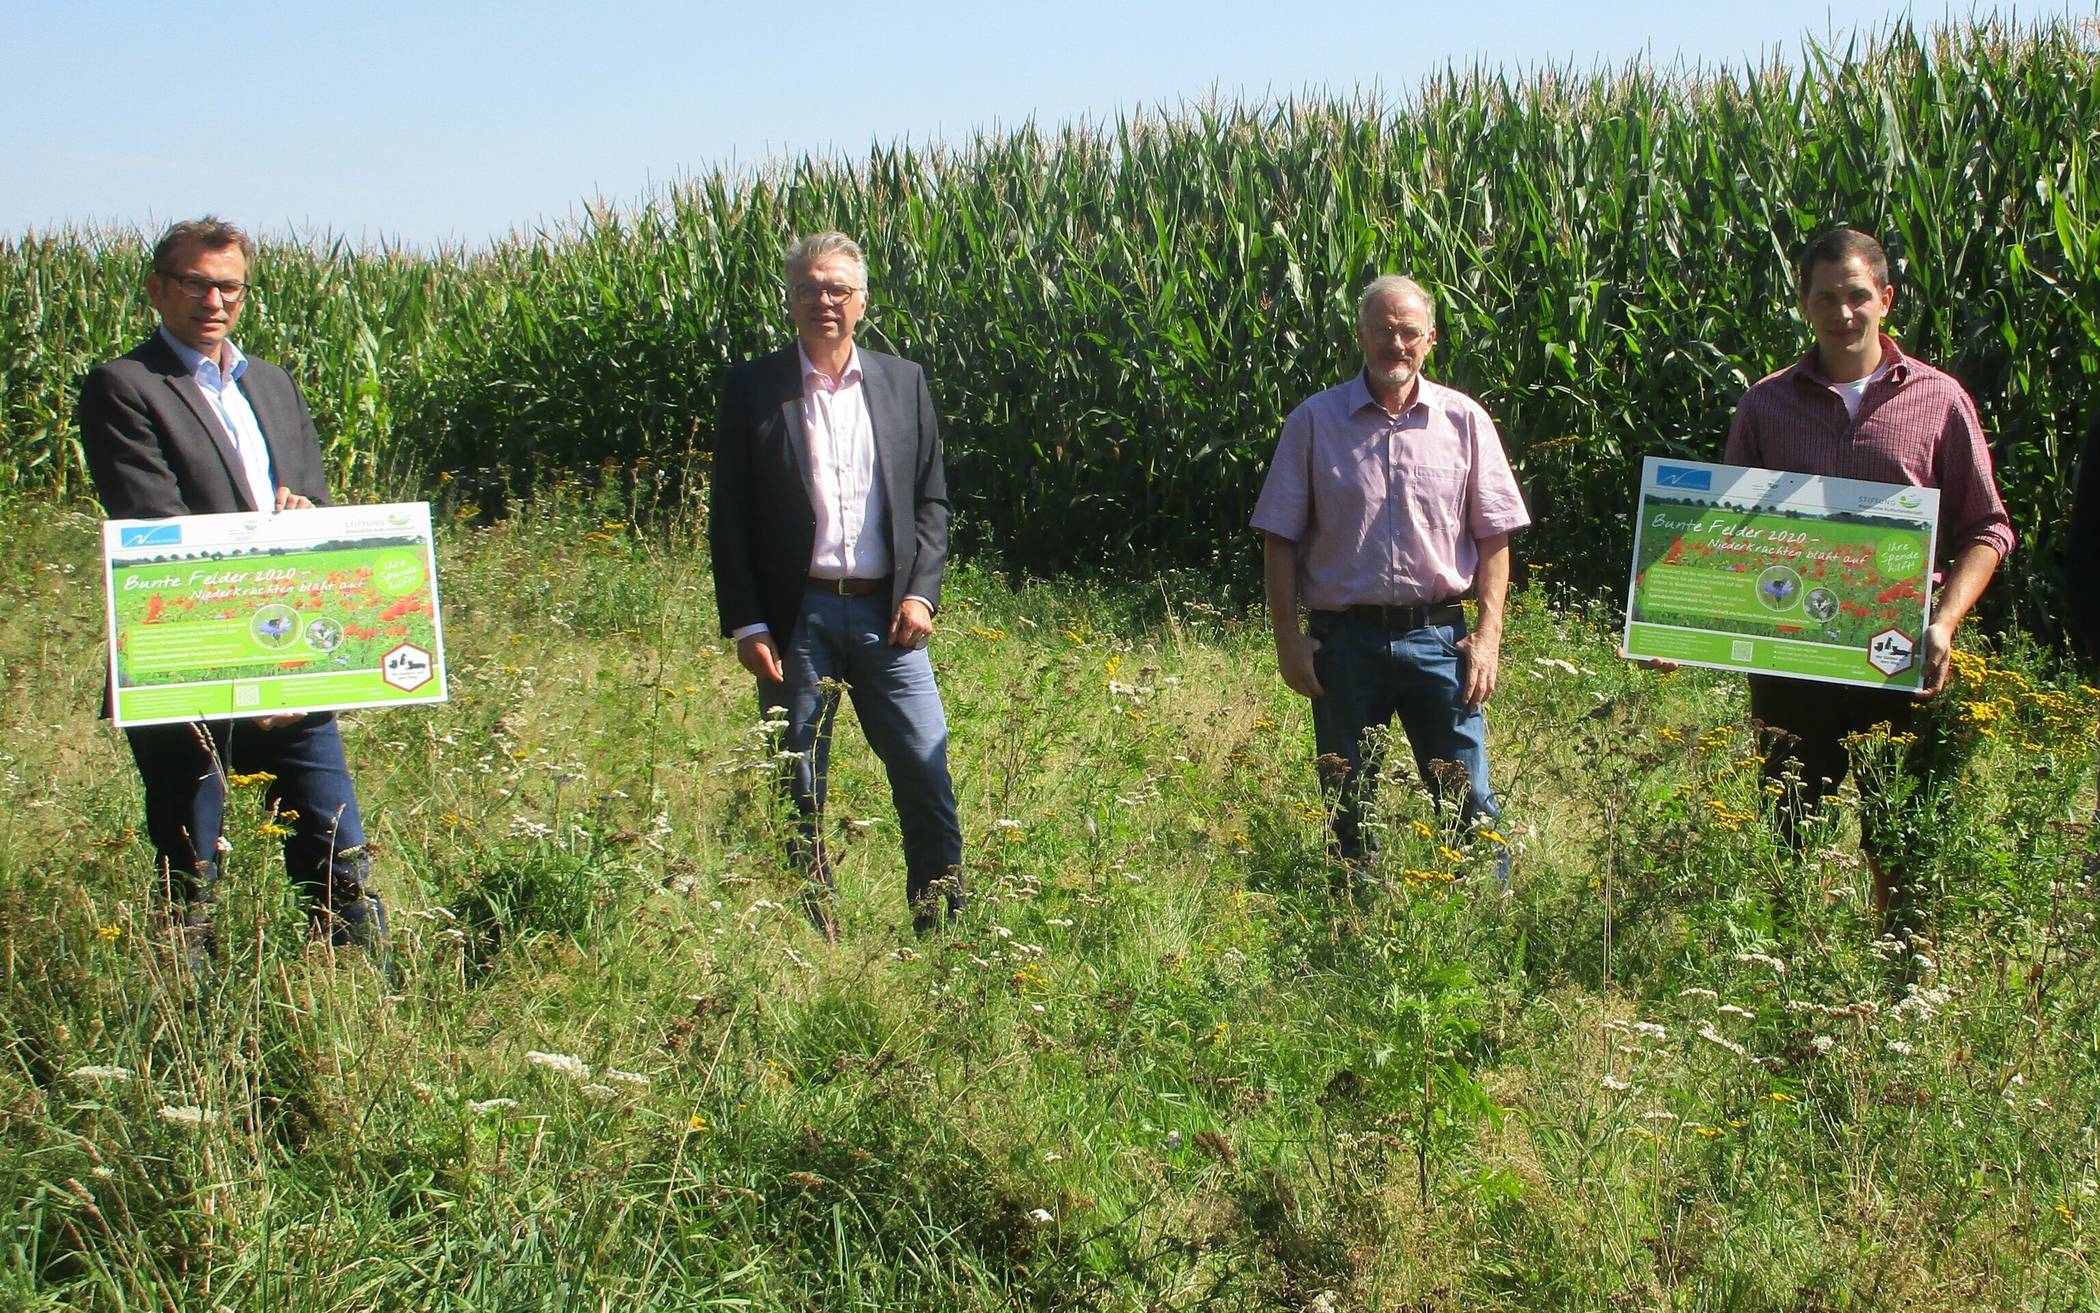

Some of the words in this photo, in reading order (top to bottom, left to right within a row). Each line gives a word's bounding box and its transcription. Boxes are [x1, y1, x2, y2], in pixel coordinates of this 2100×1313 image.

[1651, 513, 1702, 533] Bunte
[1707, 519, 1763, 539] Felder
[1767, 529, 1807, 545] 2020
[1843, 553, 1869, 565] auf
[1880, 551, 1920, 566] Spende
[124, 573, 181, 591] Bunte
[188, 569, 250, 587] Felder
[255, 567, 297, 582] 2020
[339, 577, 366, 589] auf
